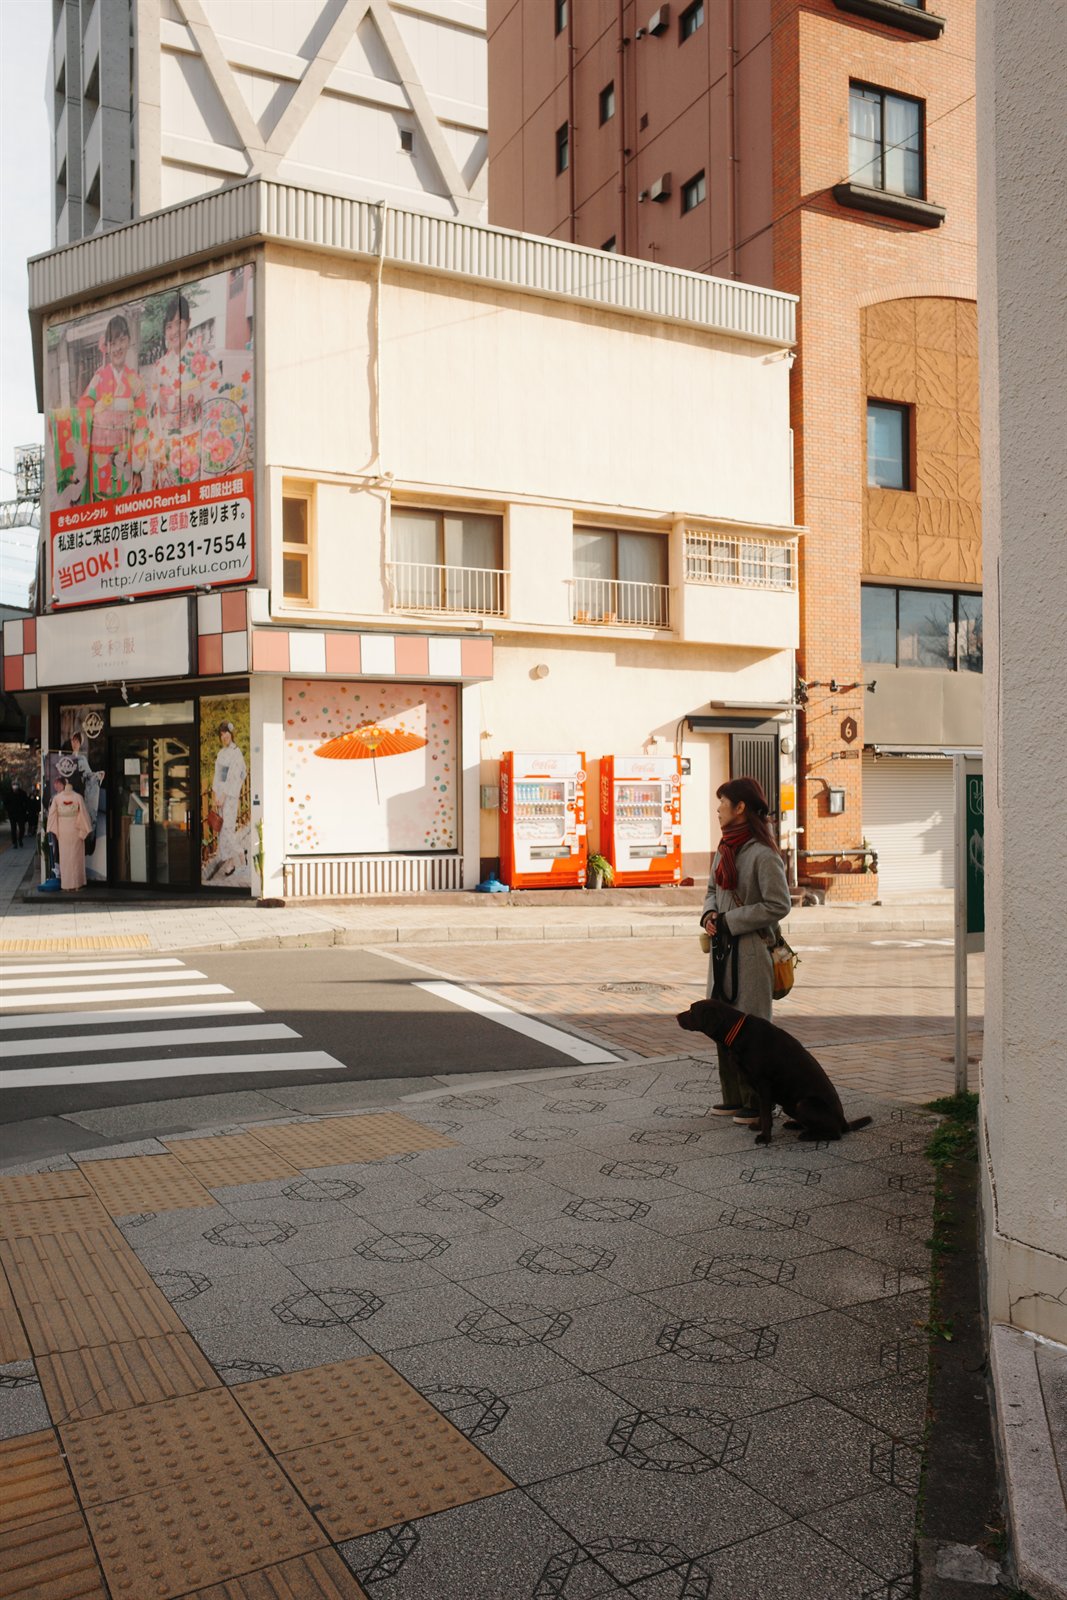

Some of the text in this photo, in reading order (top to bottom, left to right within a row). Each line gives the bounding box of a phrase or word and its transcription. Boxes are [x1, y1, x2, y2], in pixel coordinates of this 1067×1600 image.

[57, 479, 244, 528] きものレンタル KIMONO Rental 和服出租
[127, 532, 247, 567] 03-6231-7554
[100, 555, 249, 589] http://aiwafuku.com/
[844, 723, 853, 738] 6
